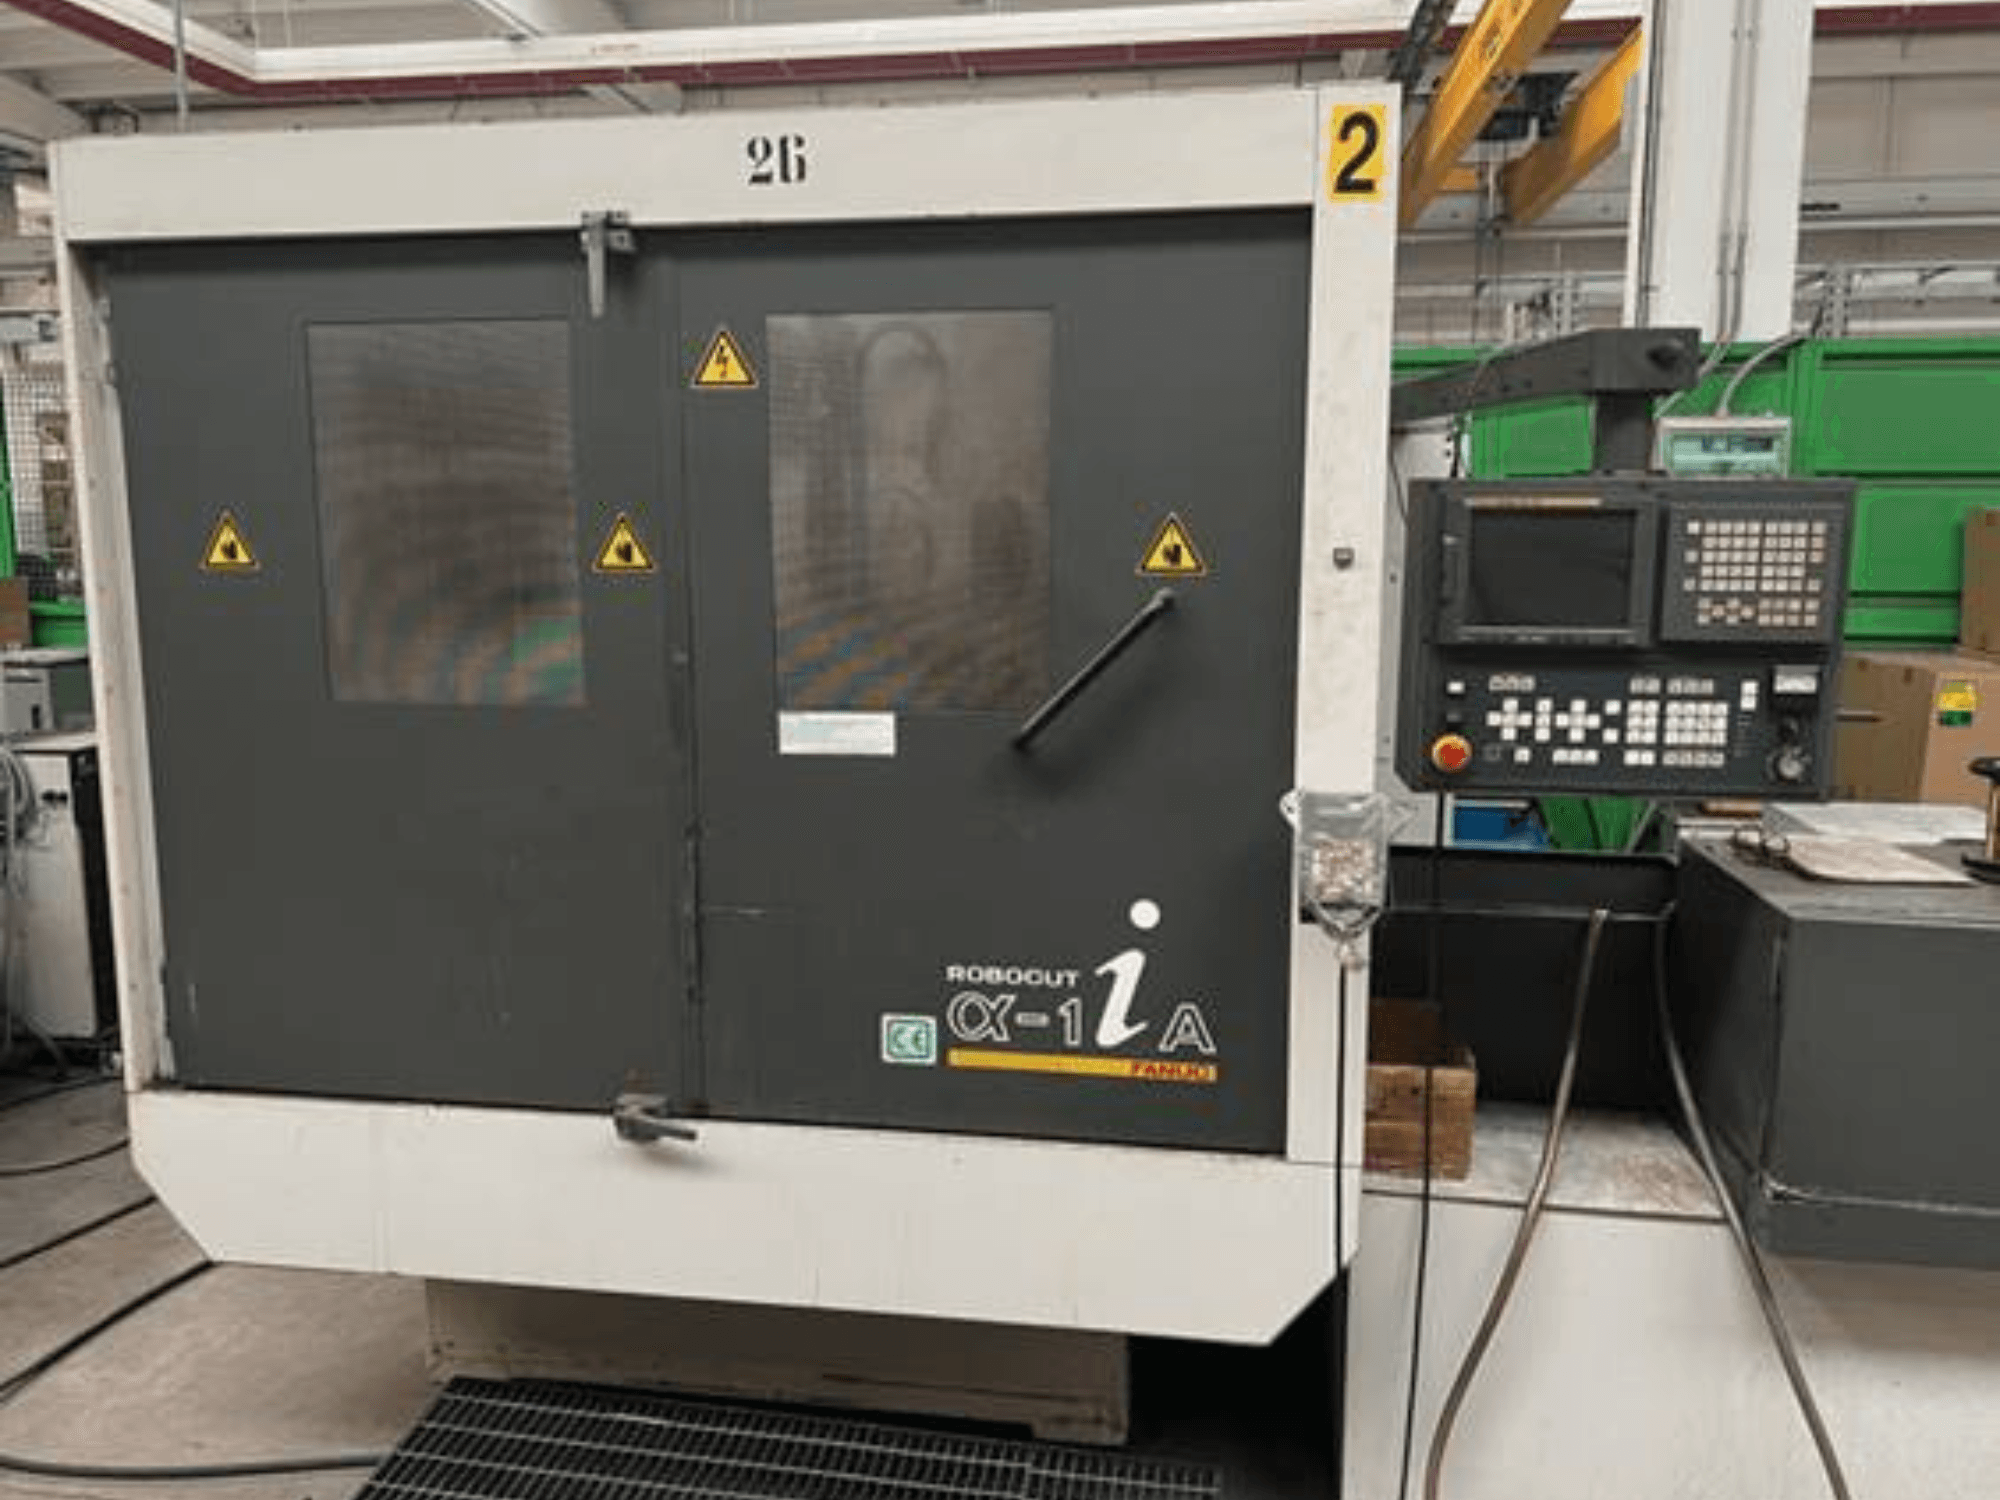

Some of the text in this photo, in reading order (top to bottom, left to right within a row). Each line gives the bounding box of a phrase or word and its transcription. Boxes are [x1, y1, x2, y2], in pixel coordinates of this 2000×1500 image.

[746, 134, 807, 184] 26
[1334, 110, 1380, 194] 2
[945, 965, 1081, 988] ROBOCUT
